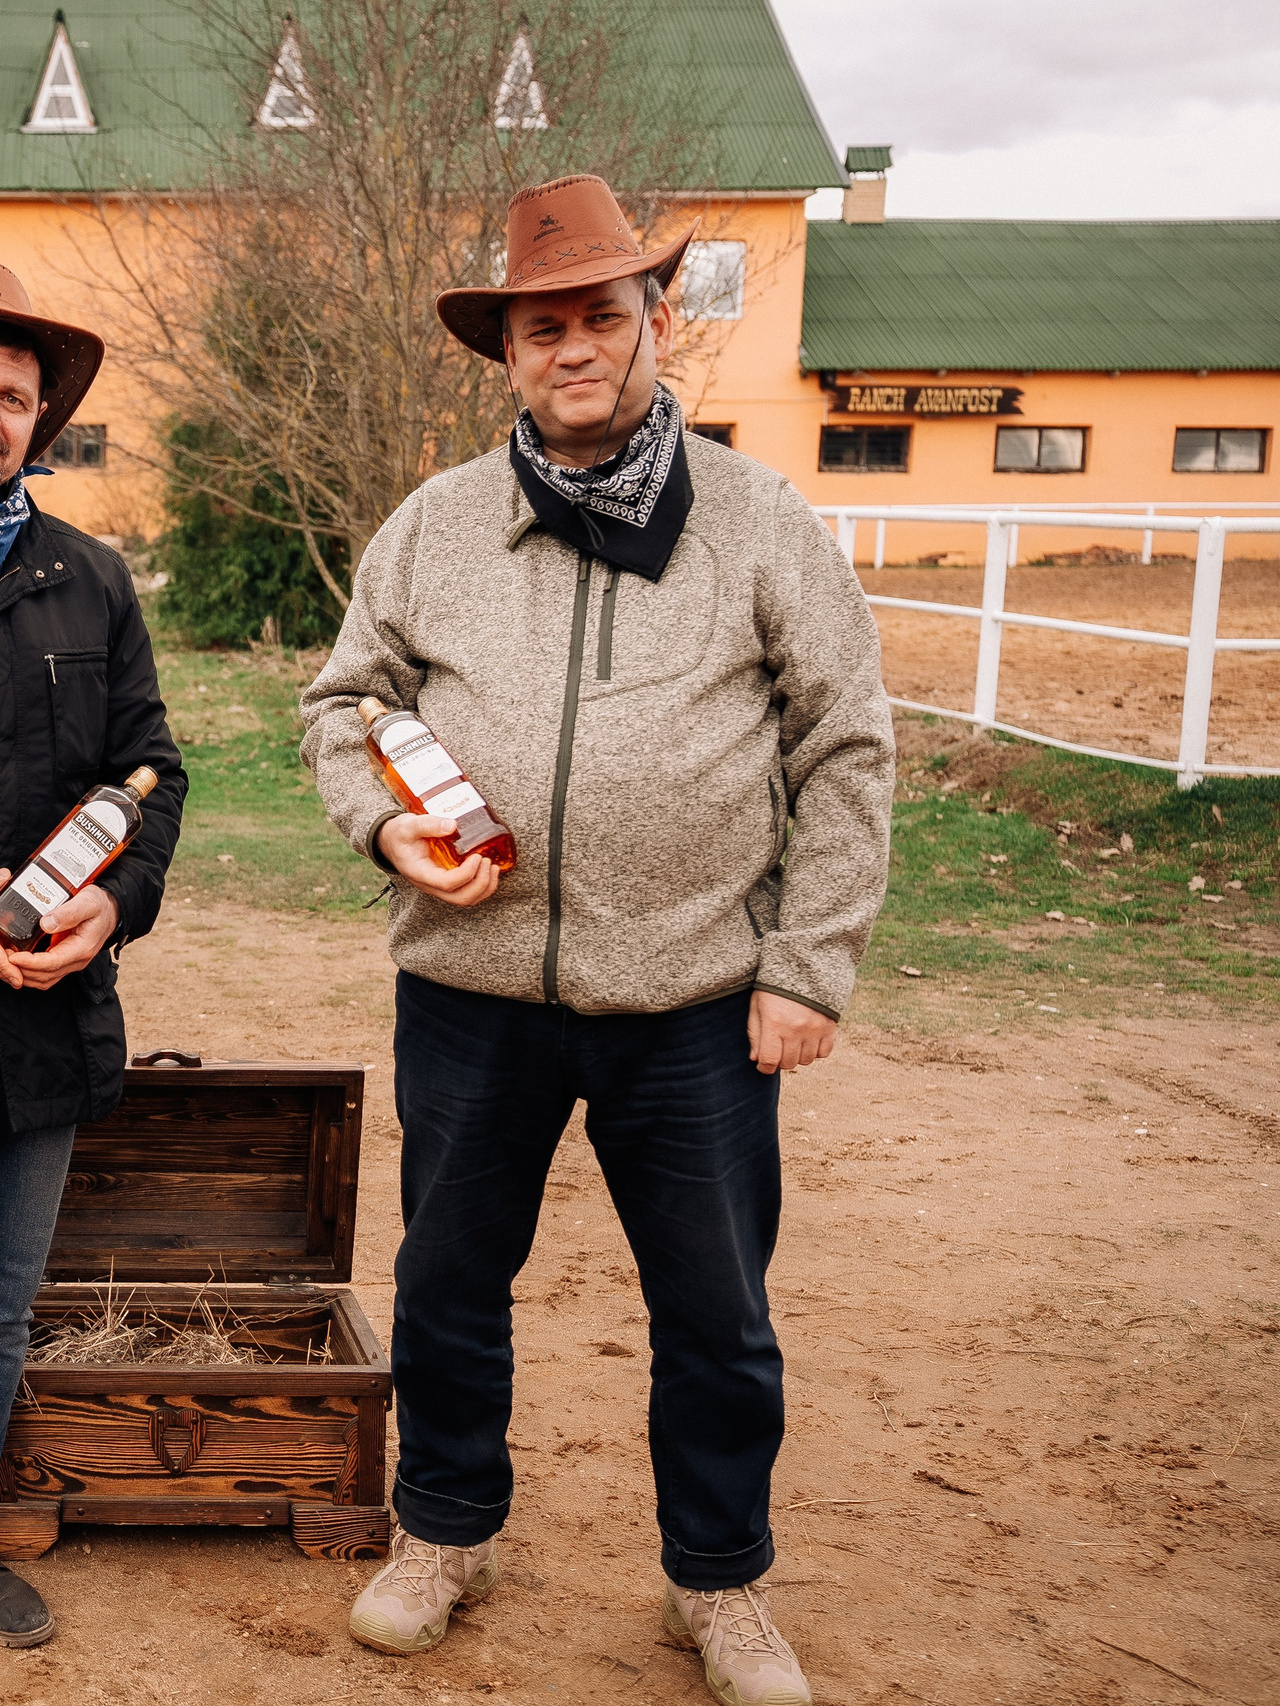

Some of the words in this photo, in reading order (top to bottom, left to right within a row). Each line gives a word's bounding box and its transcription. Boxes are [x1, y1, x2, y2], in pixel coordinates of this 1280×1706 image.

[847, 387, 907, 412] RANCH
[914, 387, 1003, 413] AVANPOST
[387, 733, 434, 760] BUSHMILLS
[68, 826, 79, 836] THE
[78, 835, 102, 858] ORIGINAL
[75, 813, 116, 852] BUSHMILLS
[6, 894, 38, 925] 1608
